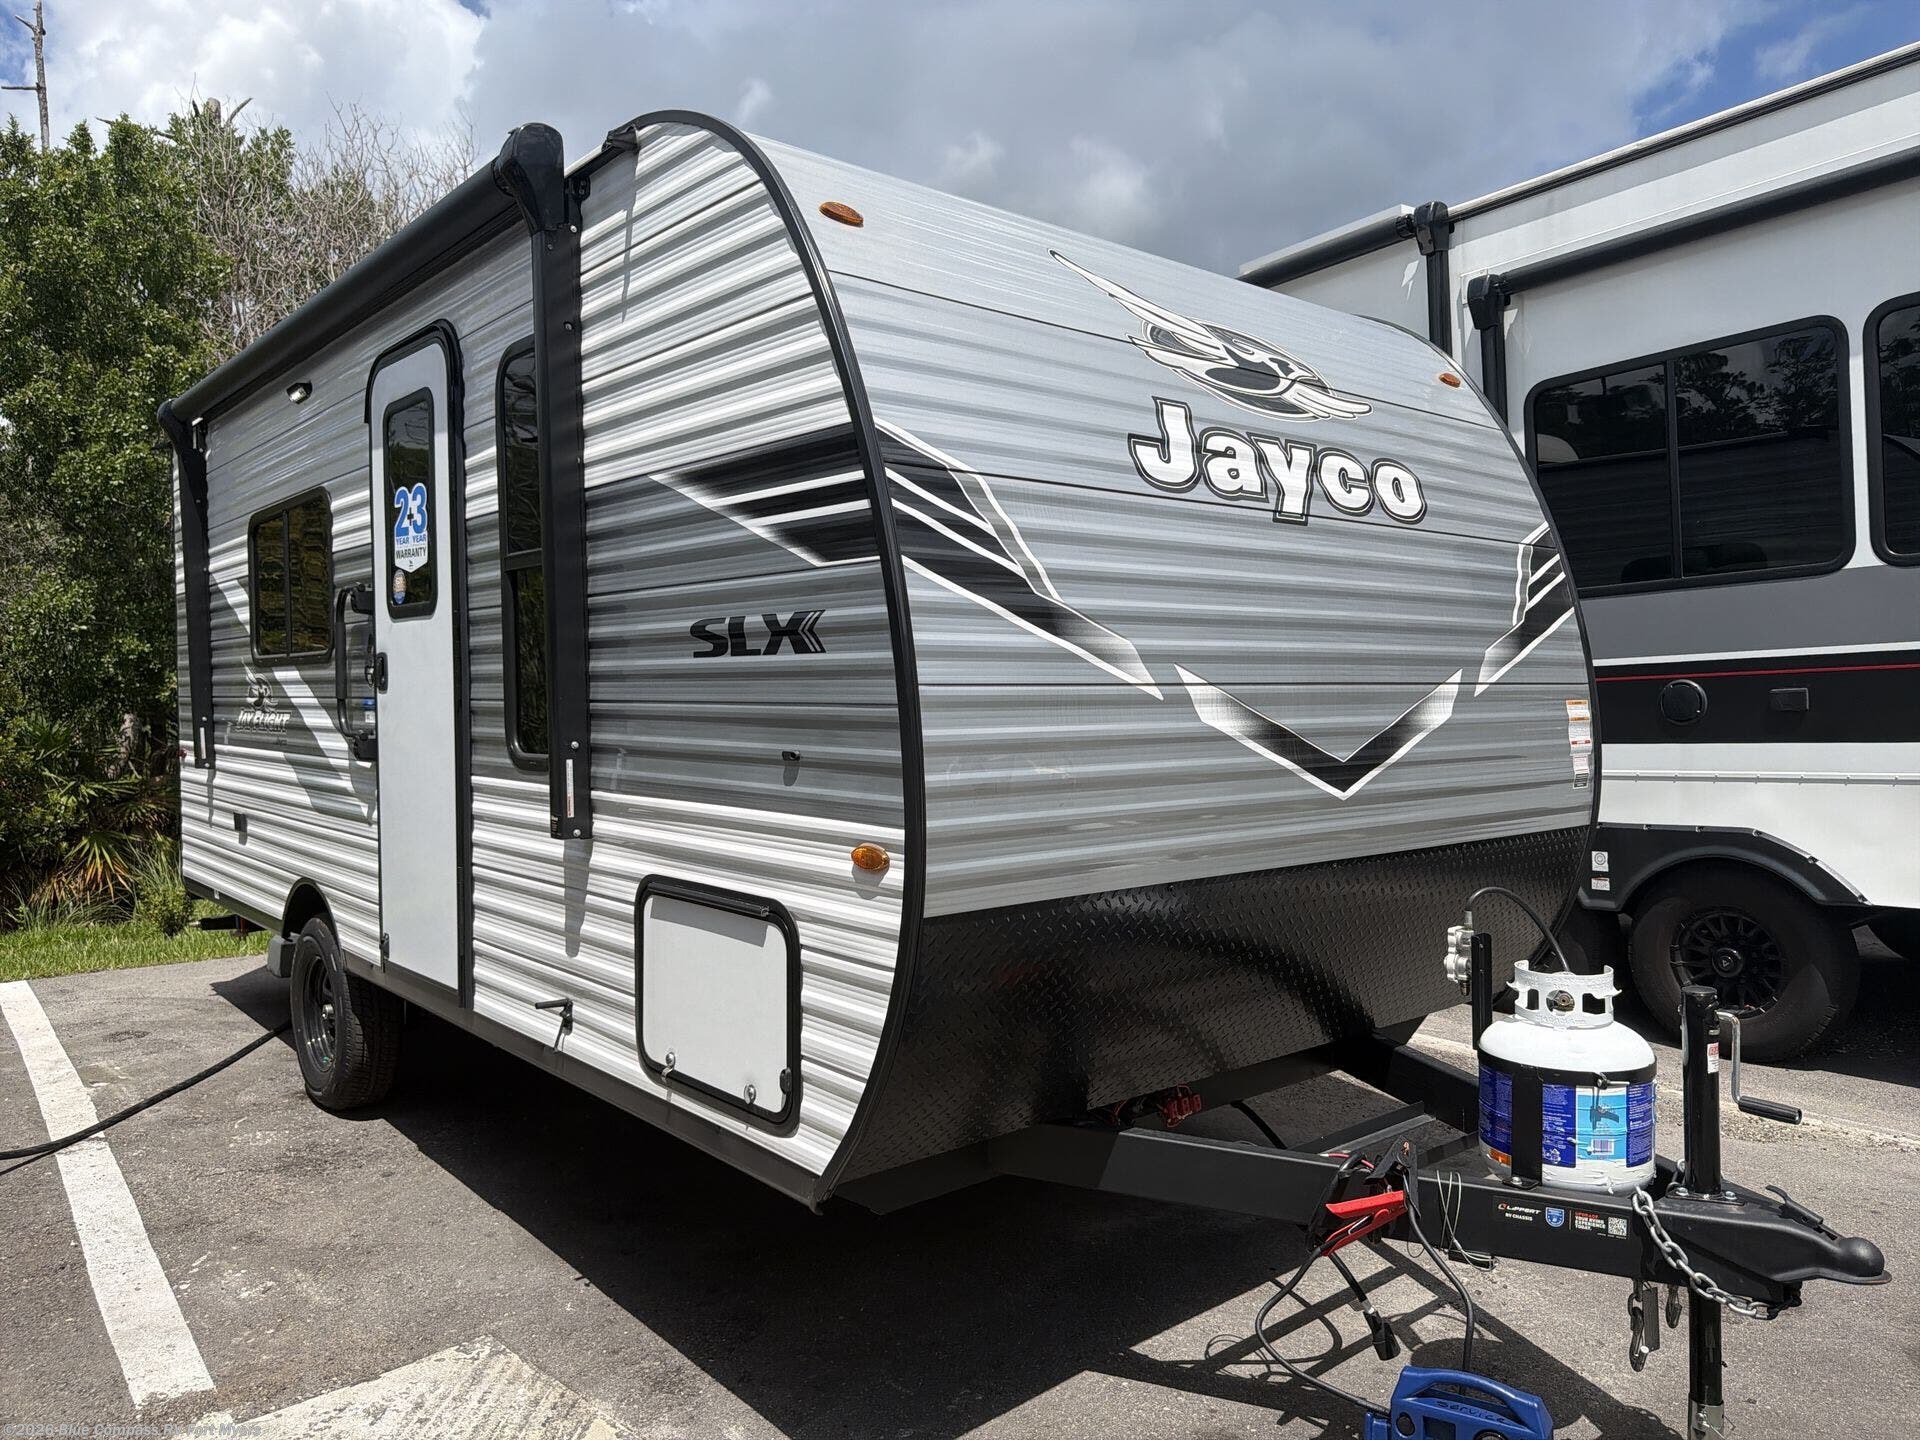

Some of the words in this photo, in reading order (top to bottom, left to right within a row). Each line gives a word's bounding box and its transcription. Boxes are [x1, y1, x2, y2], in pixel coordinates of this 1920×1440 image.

[1128, 396, 1427, 526] Jayco
[396, 536, 409, 545] YEAR
[413, 533, 426, 543] YEAR
[396, 546, 426, 559] WARRANTY
[690, 609, 826, 658] SLX
[1512, 1213, 1533, 1221] CHASSIS
